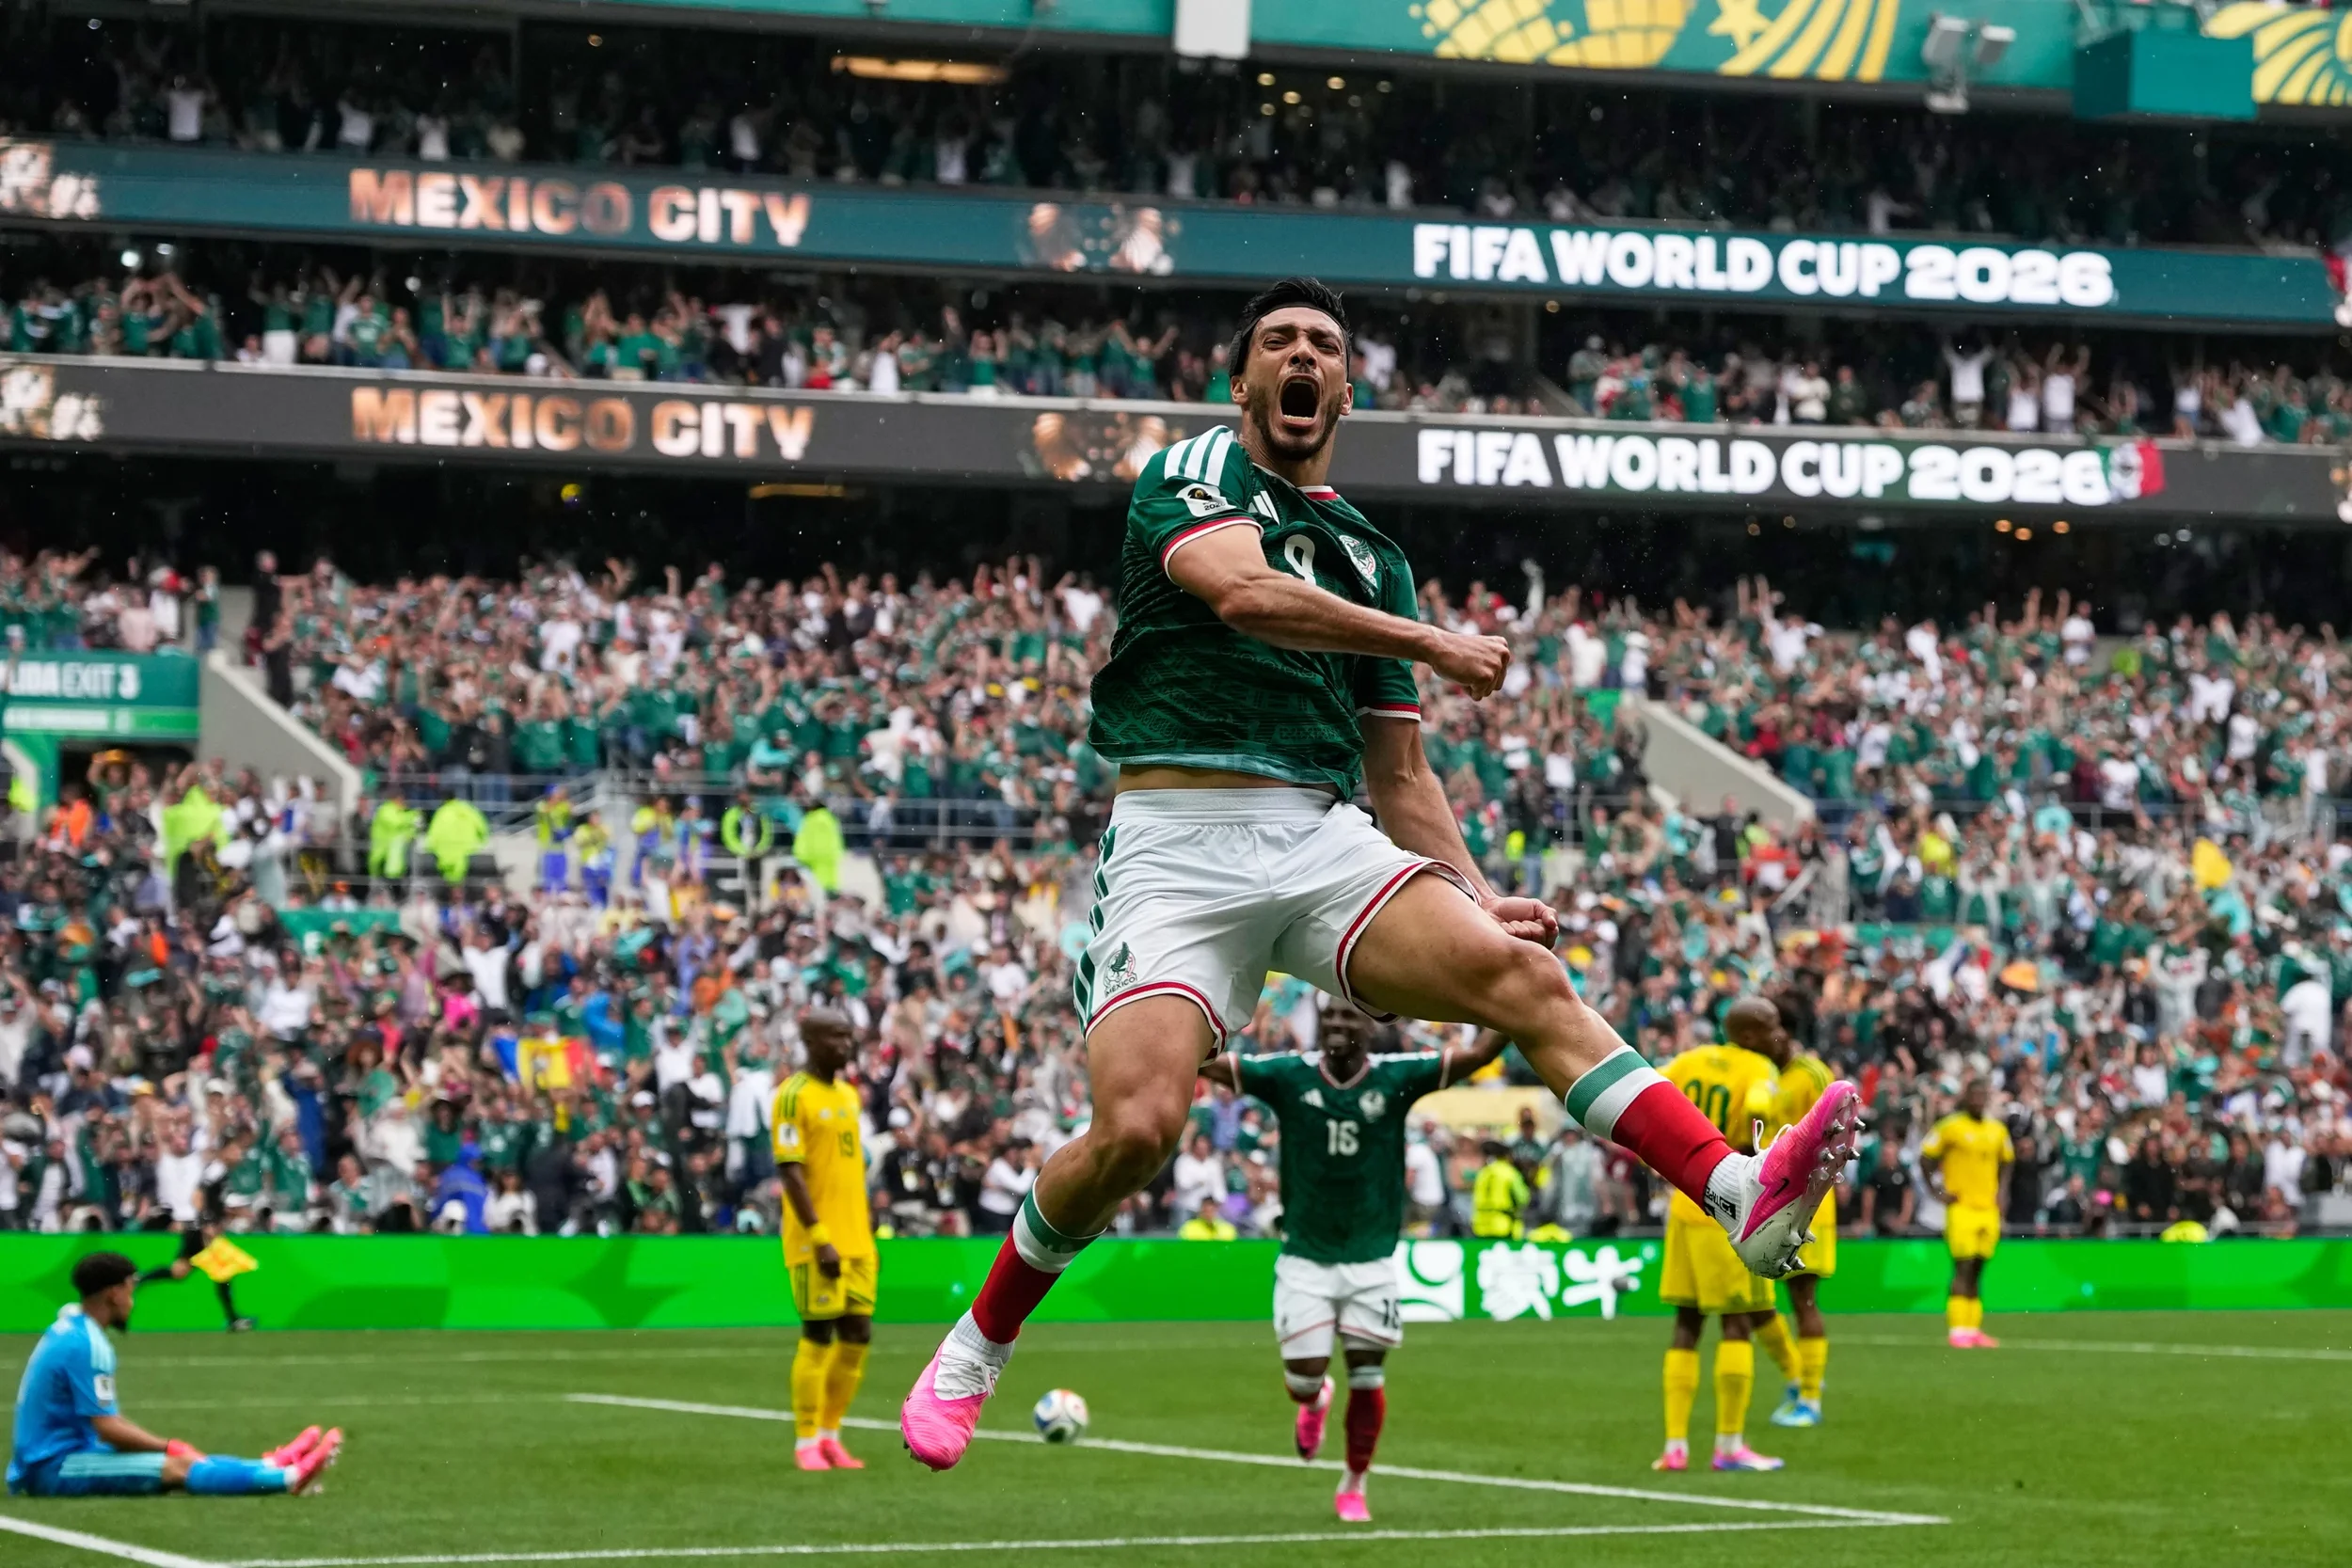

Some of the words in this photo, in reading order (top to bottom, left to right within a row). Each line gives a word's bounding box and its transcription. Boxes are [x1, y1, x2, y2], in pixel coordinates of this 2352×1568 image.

[349, 168, 632, 236] MEXICO
[649, 185, 811, 247] CITY
[1413, 223, 1549, 283] FIFA
[1550, 230, 1773, 292] WORLD
[1778, 239, 1901, 297] CUP
[1904, 245, 2114, 307] 2026
[351, 387, 637, 453] MEXICO
[651, 400, 815, 461] CITY
[1417, 429, 1552, 487] FIFA
[1554, 435, 1777, 495] WORLD
[1781, 441, 1904, 499] CUP
[1907, 445, 2110, 506] 2026
[1284, 533, 1317, 586] 9
[62, 662, 116, 699] EXIT
[118, 664, 140, 700] 3
[1105, 976, 1136, 997] MEXICO
[838, 1130, 854, 1158] 19
[1326, 1118, 1360, 1156] 16
[1477, 1242, 1644, 1321] 蒙牛
